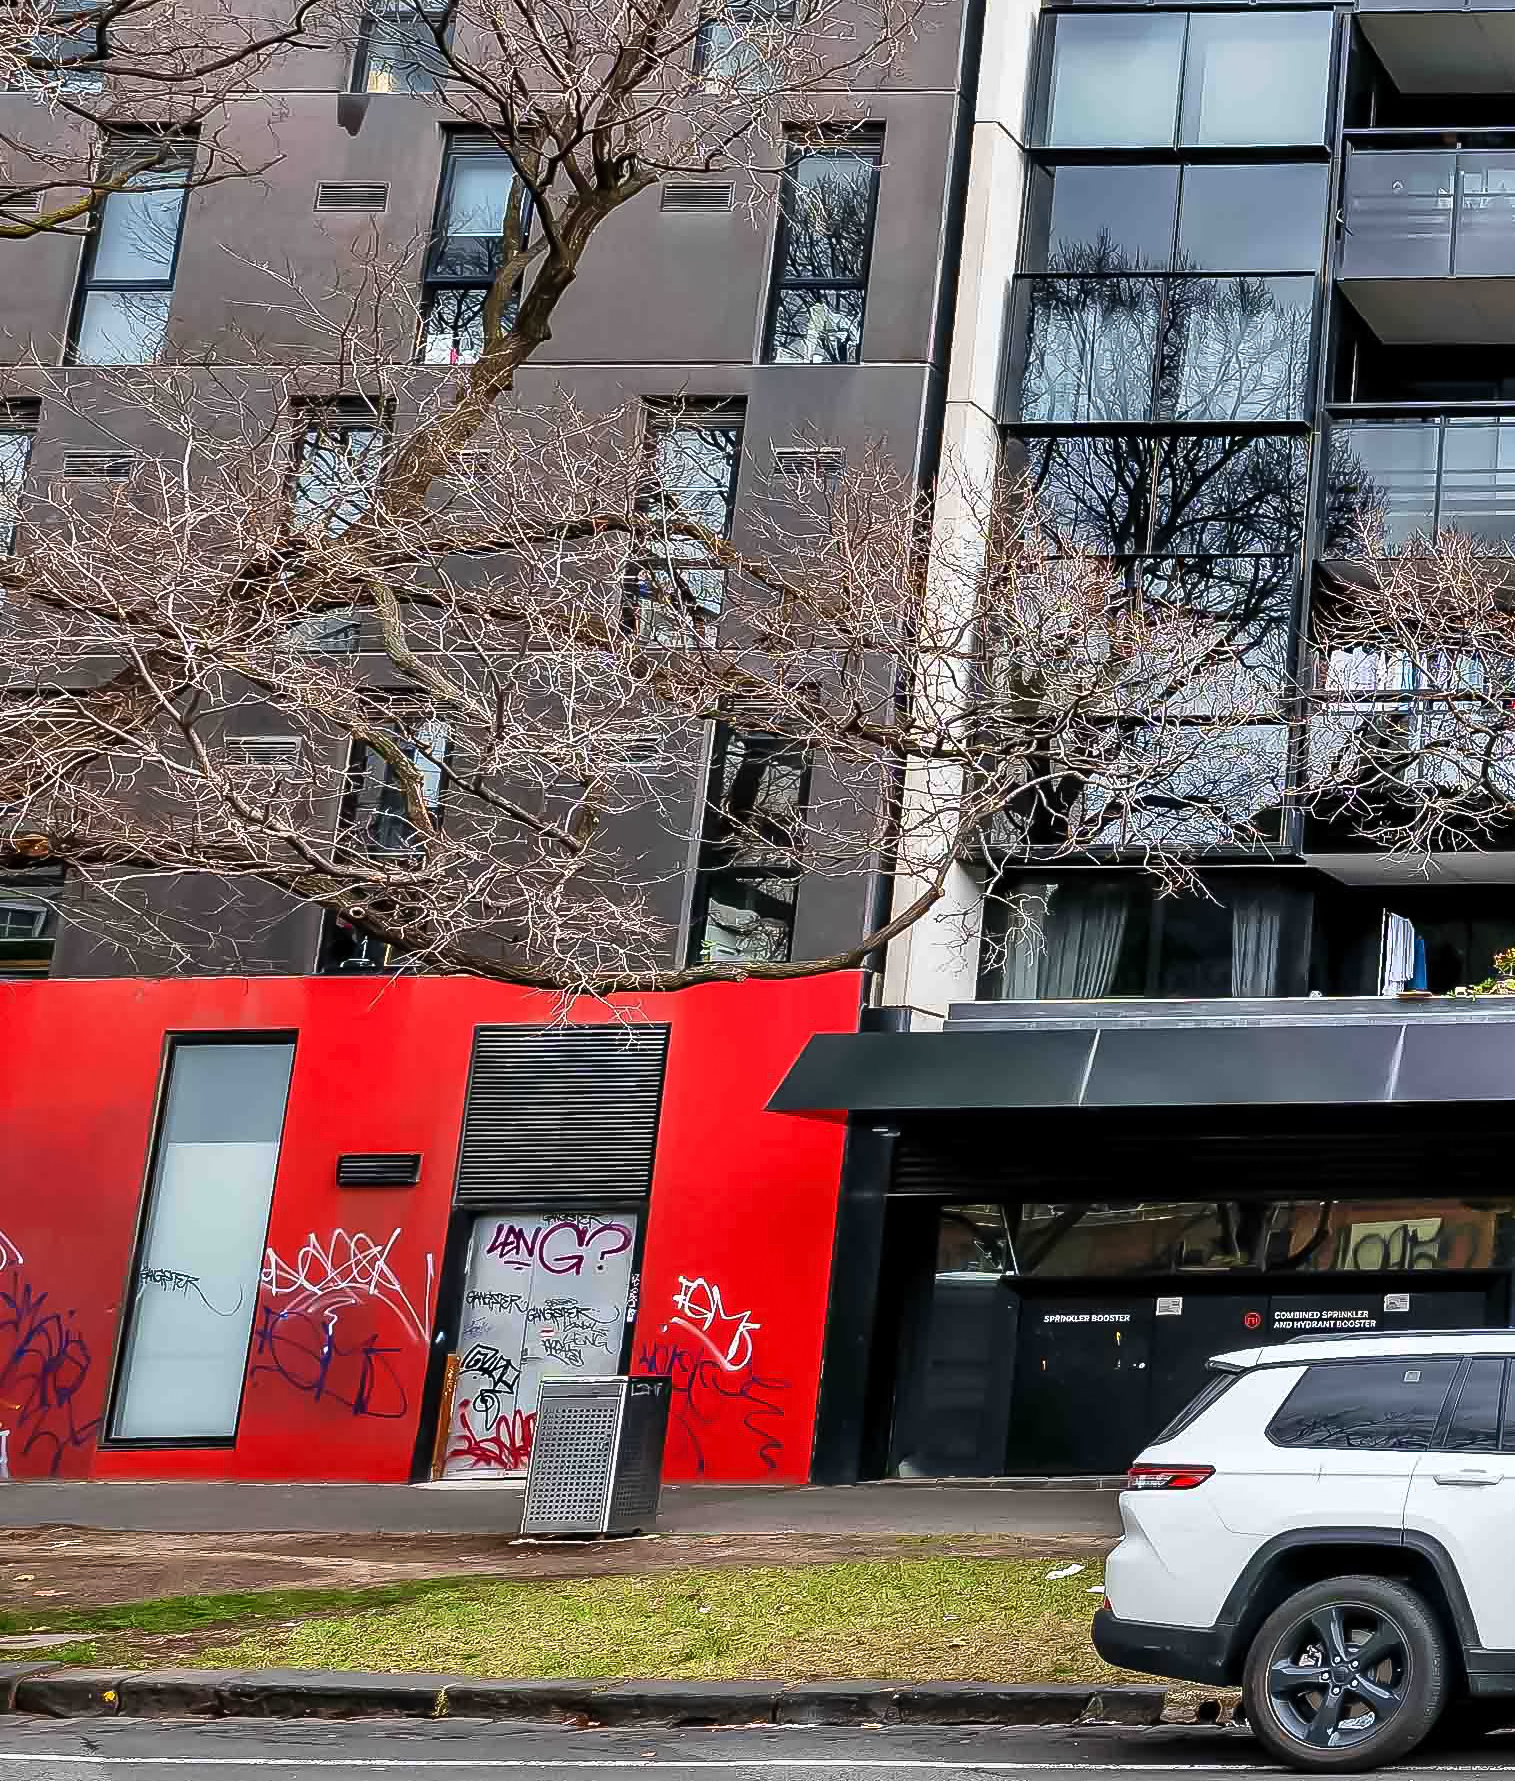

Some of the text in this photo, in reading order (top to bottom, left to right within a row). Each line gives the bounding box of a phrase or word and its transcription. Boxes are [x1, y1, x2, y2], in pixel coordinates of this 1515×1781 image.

[1091, 1314, 1131, 1322] BOOSTER
[1274, 1310, 1369, 1320] COMBINED SPRINKLER
[1273, 1319, 1377, 1329] AND HYDRANT BOOSTER
